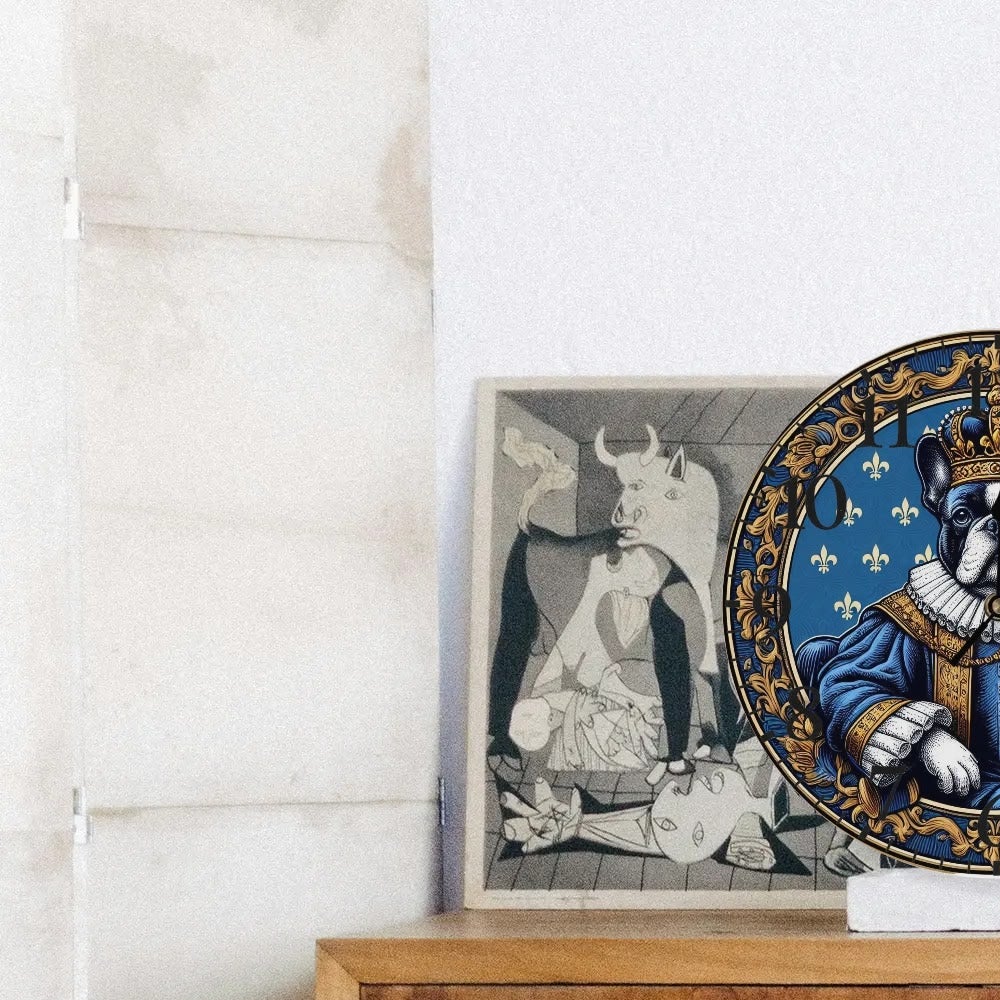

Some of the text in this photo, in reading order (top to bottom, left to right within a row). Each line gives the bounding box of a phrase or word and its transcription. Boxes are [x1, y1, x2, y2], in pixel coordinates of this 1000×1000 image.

[860, 394, 915, 448] 11
[785, 475, 846, 530] 10
[754, 585, 792, 639] 9
[787, 687, 822, 741] 8
[872, 766, 913, 819] 7
